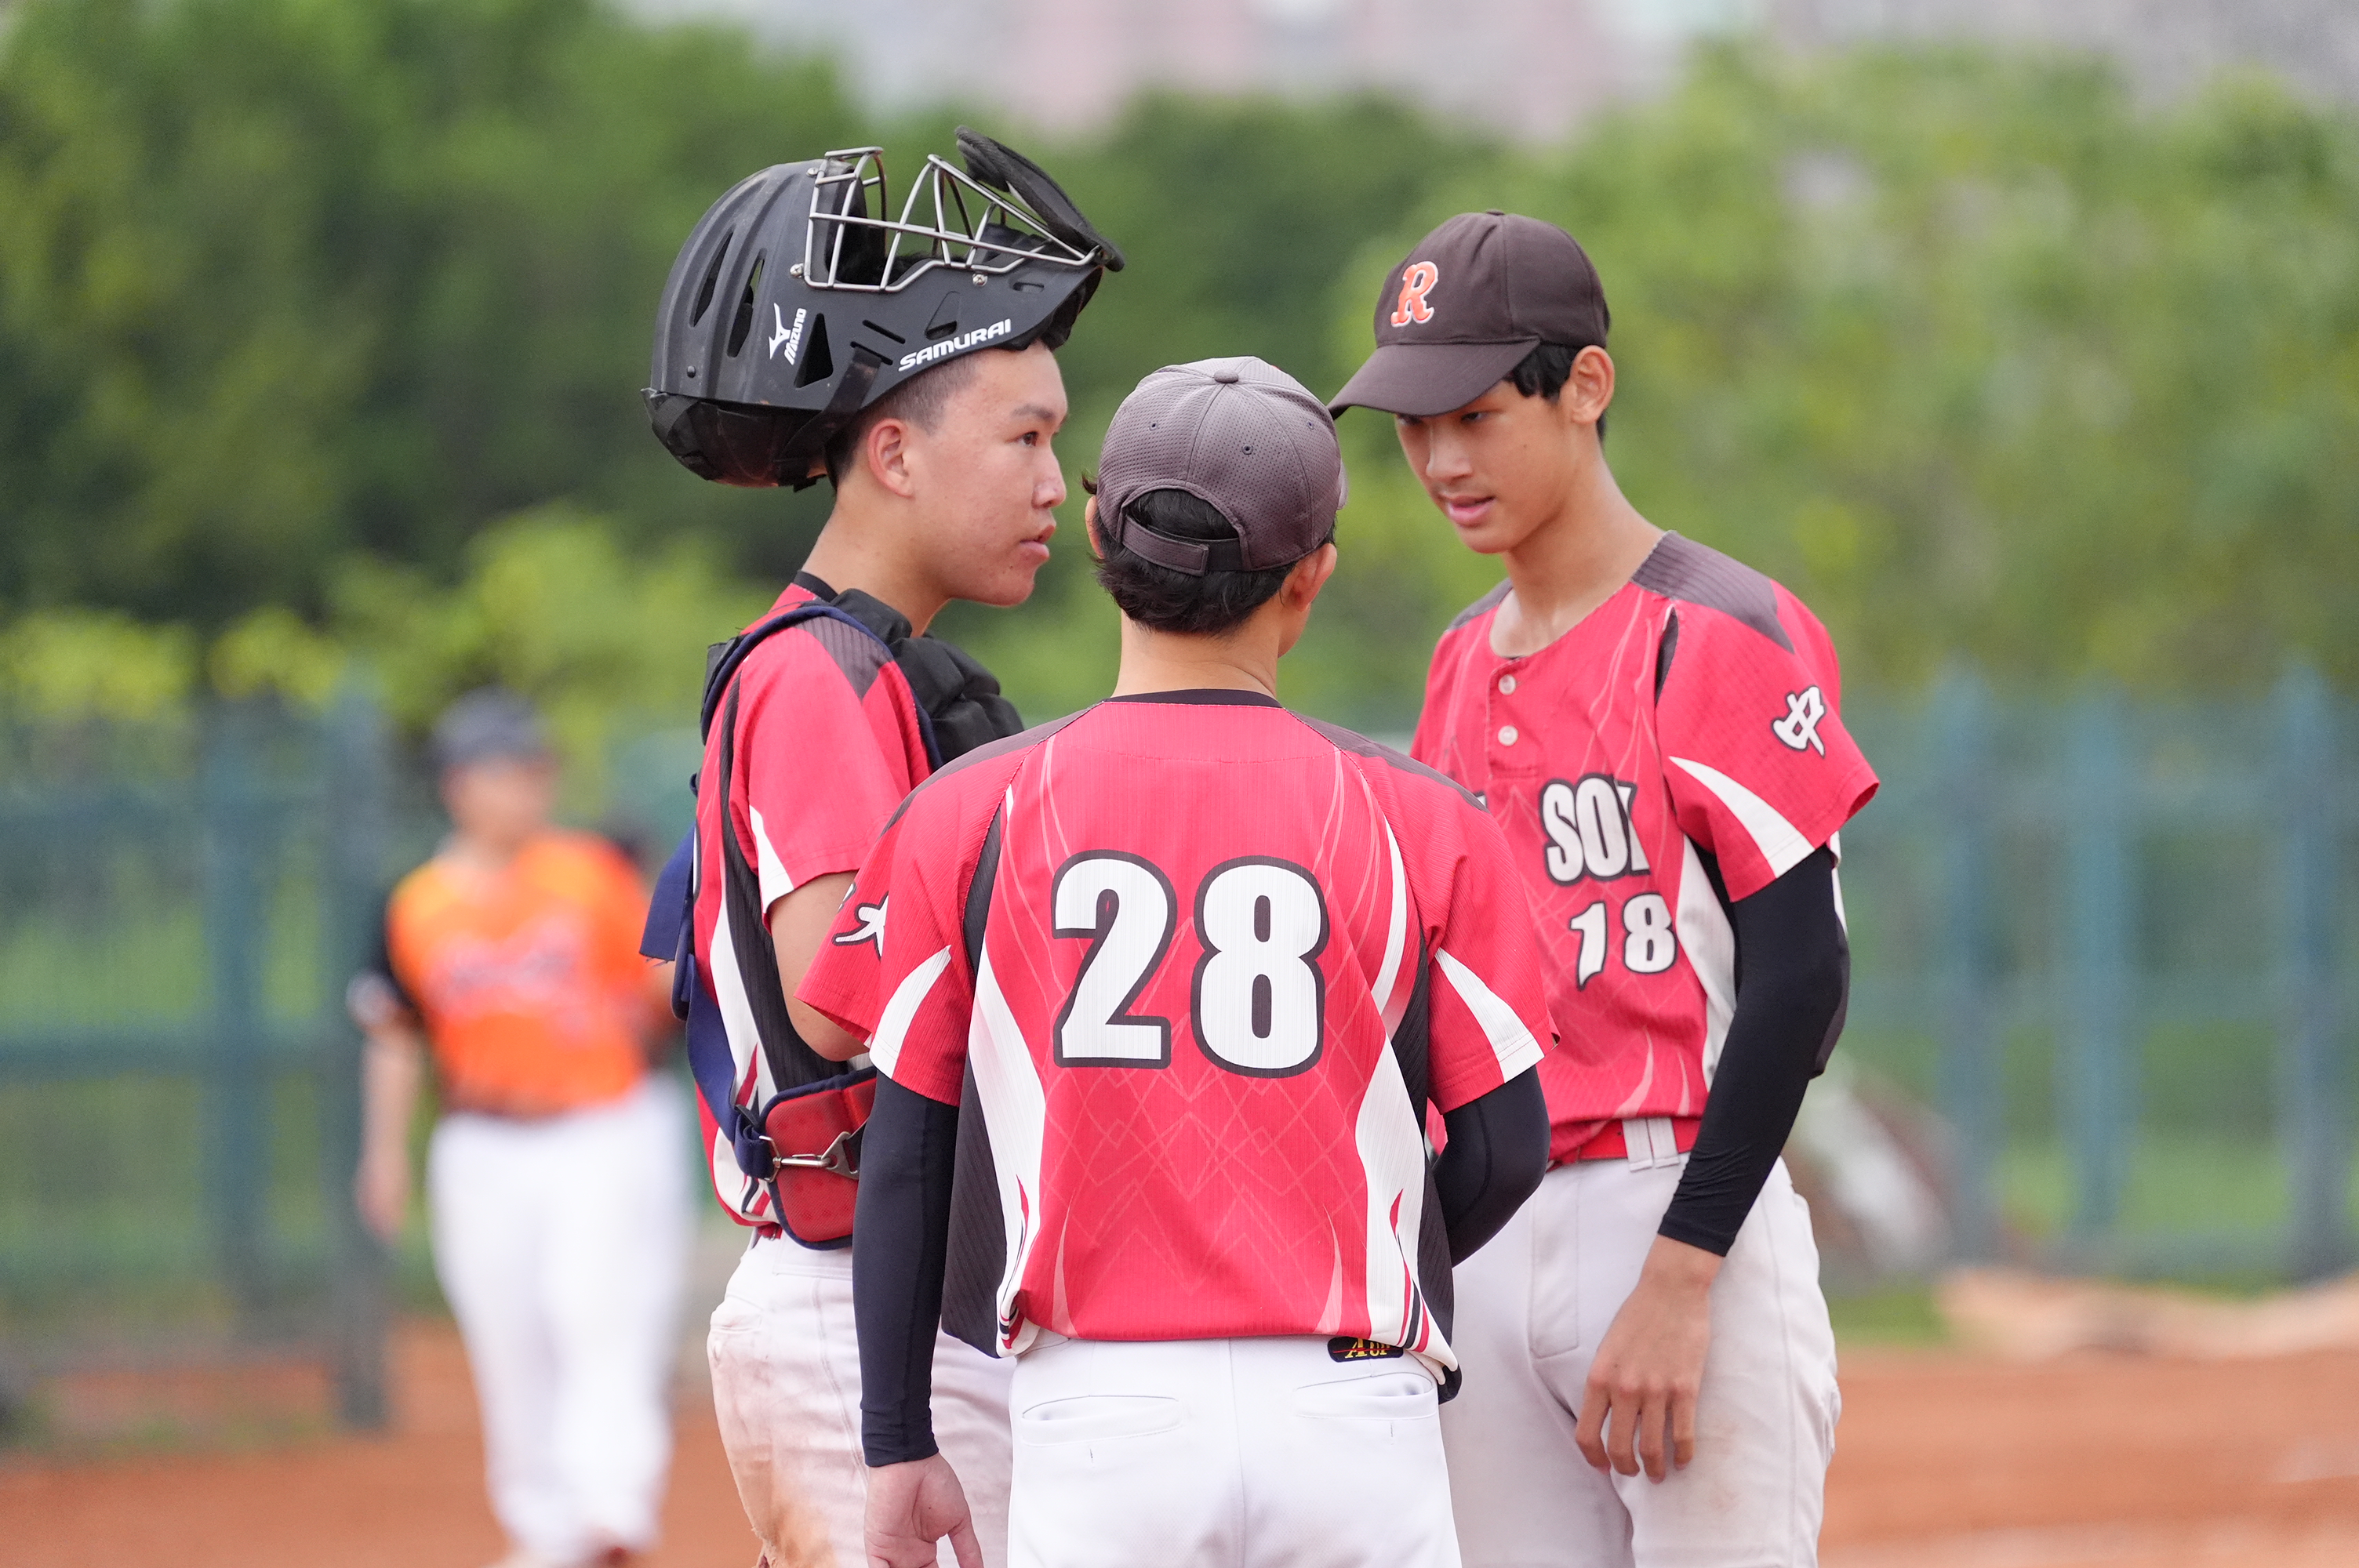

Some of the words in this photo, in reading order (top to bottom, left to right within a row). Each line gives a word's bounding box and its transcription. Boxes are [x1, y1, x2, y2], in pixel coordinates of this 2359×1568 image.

[1390, 261, 1438, 328] R
[784, 308, 807, 365] MIZUNO
[899, 318, 1012, 372] SAMURAI
[1772, 684, 1826, 759] 中
[1051, 848, 1330, 1079] 28
[1570, 892, 1677, 992] 18
